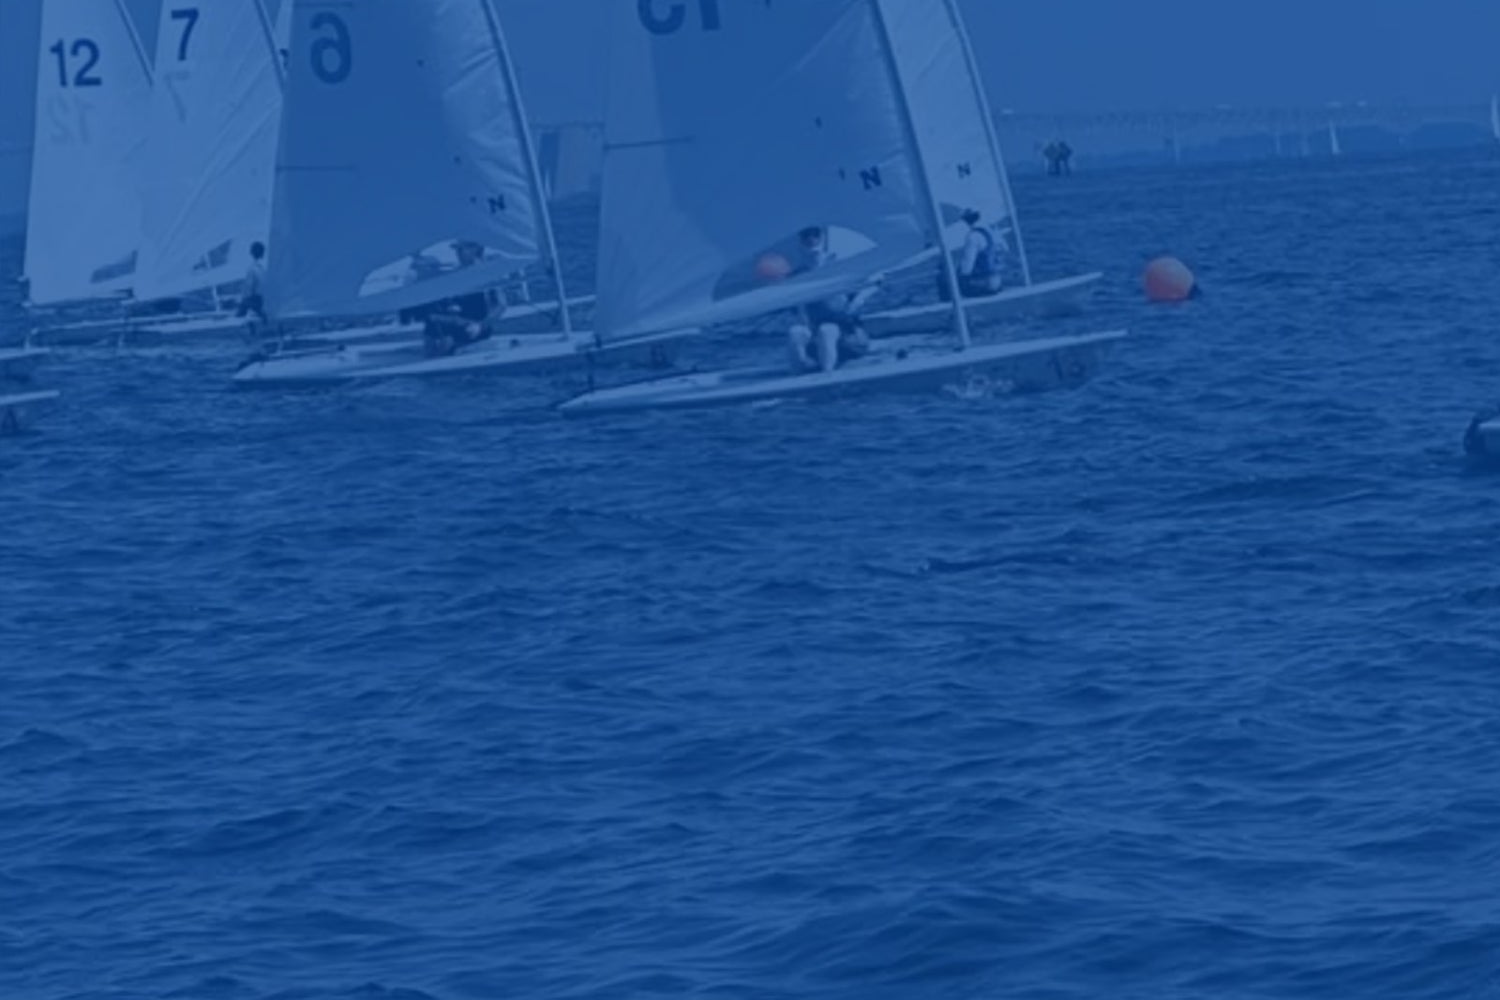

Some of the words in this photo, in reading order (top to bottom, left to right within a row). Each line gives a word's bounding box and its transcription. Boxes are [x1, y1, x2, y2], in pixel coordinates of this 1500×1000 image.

[171, 8, 199, 61] 7
[49, 38, 102, 87] 12
[858, 165, 882, 191] N
